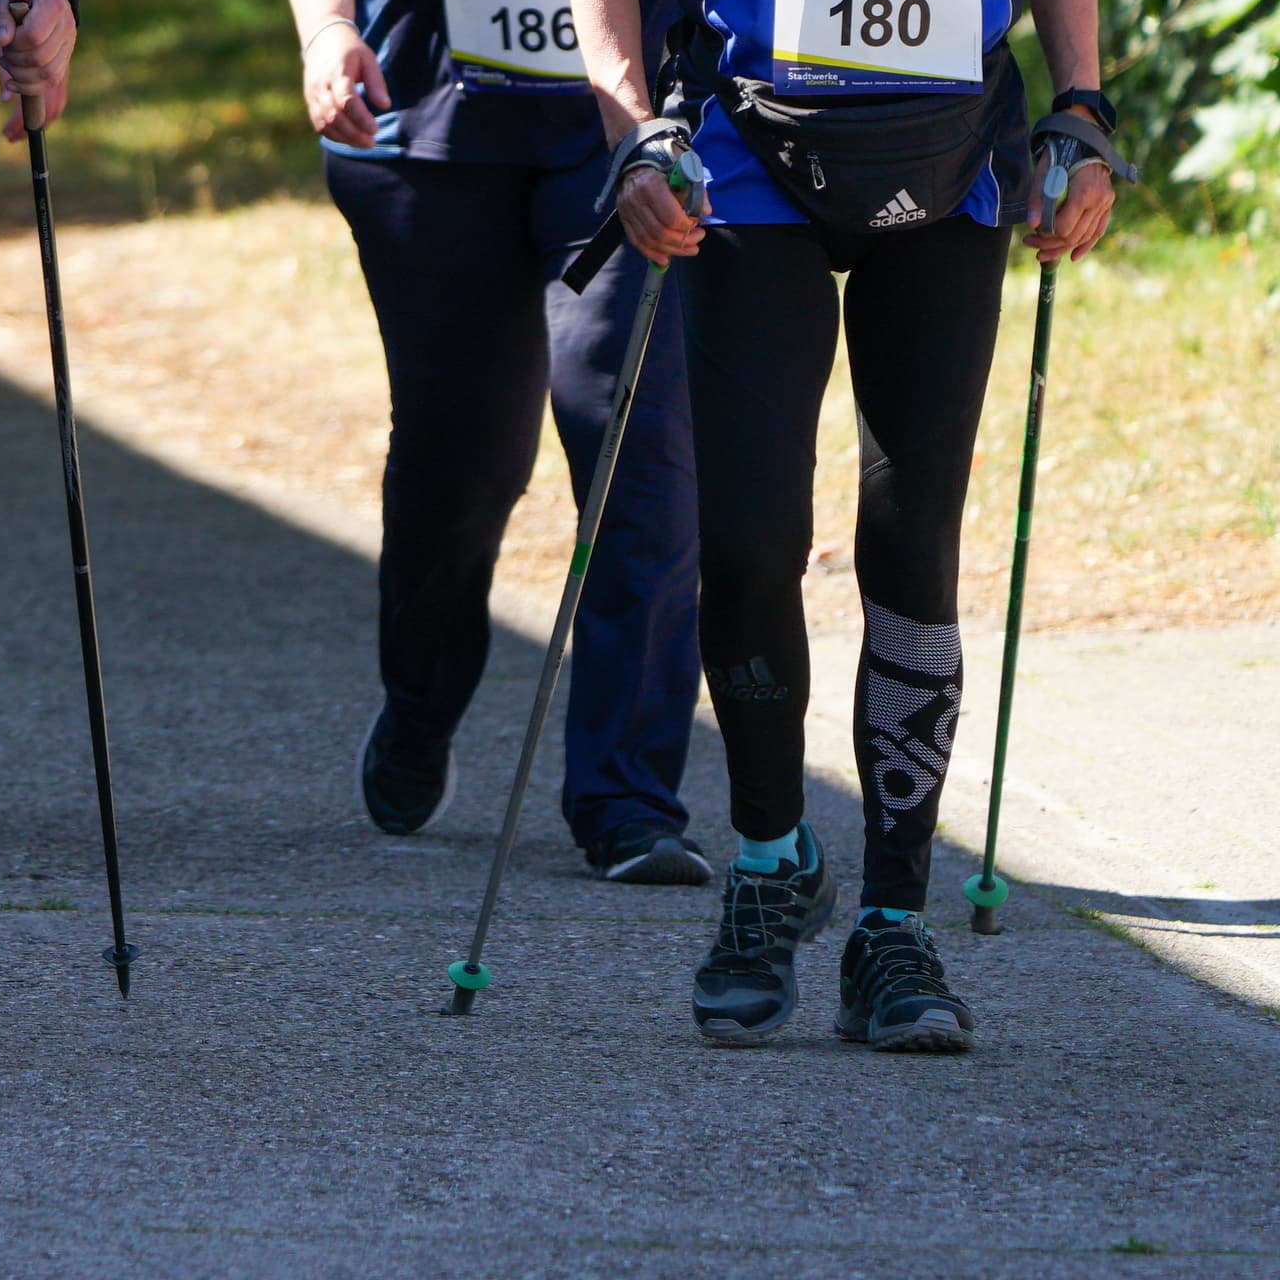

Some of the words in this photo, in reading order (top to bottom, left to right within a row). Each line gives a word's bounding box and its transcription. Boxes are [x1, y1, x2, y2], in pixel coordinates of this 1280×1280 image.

[491, 6, 579, 52] 186
[787, 71, 839, 80] Stadtwerke
[868, 208, 927, 228] adidas
